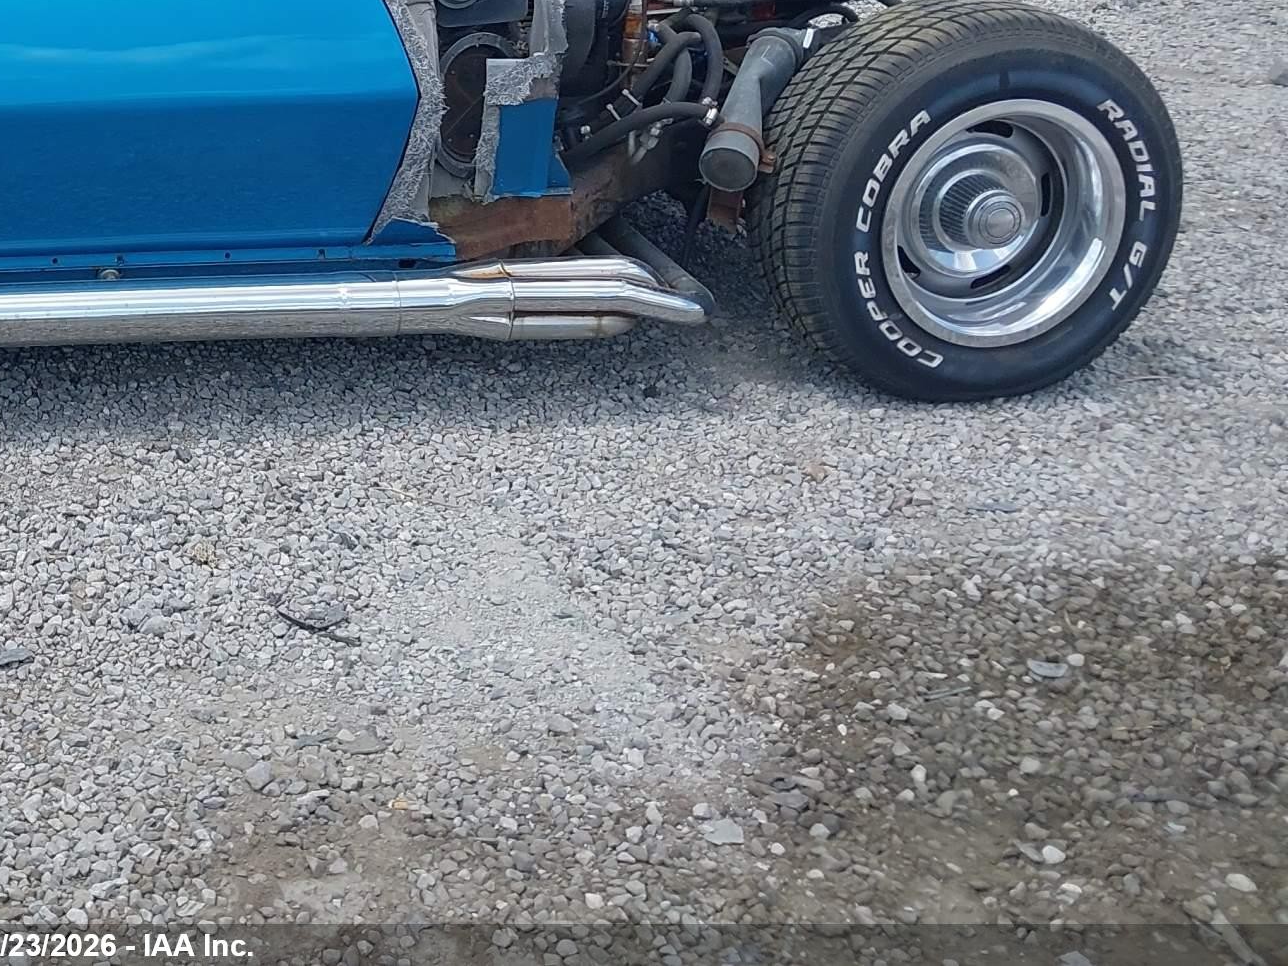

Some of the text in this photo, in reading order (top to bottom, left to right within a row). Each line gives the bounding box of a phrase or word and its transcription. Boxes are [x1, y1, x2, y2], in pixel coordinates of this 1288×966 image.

[855, 110, 944, 369] COOPER COBRA
[1096, 99, 1157, 311] RADIAL G/T
